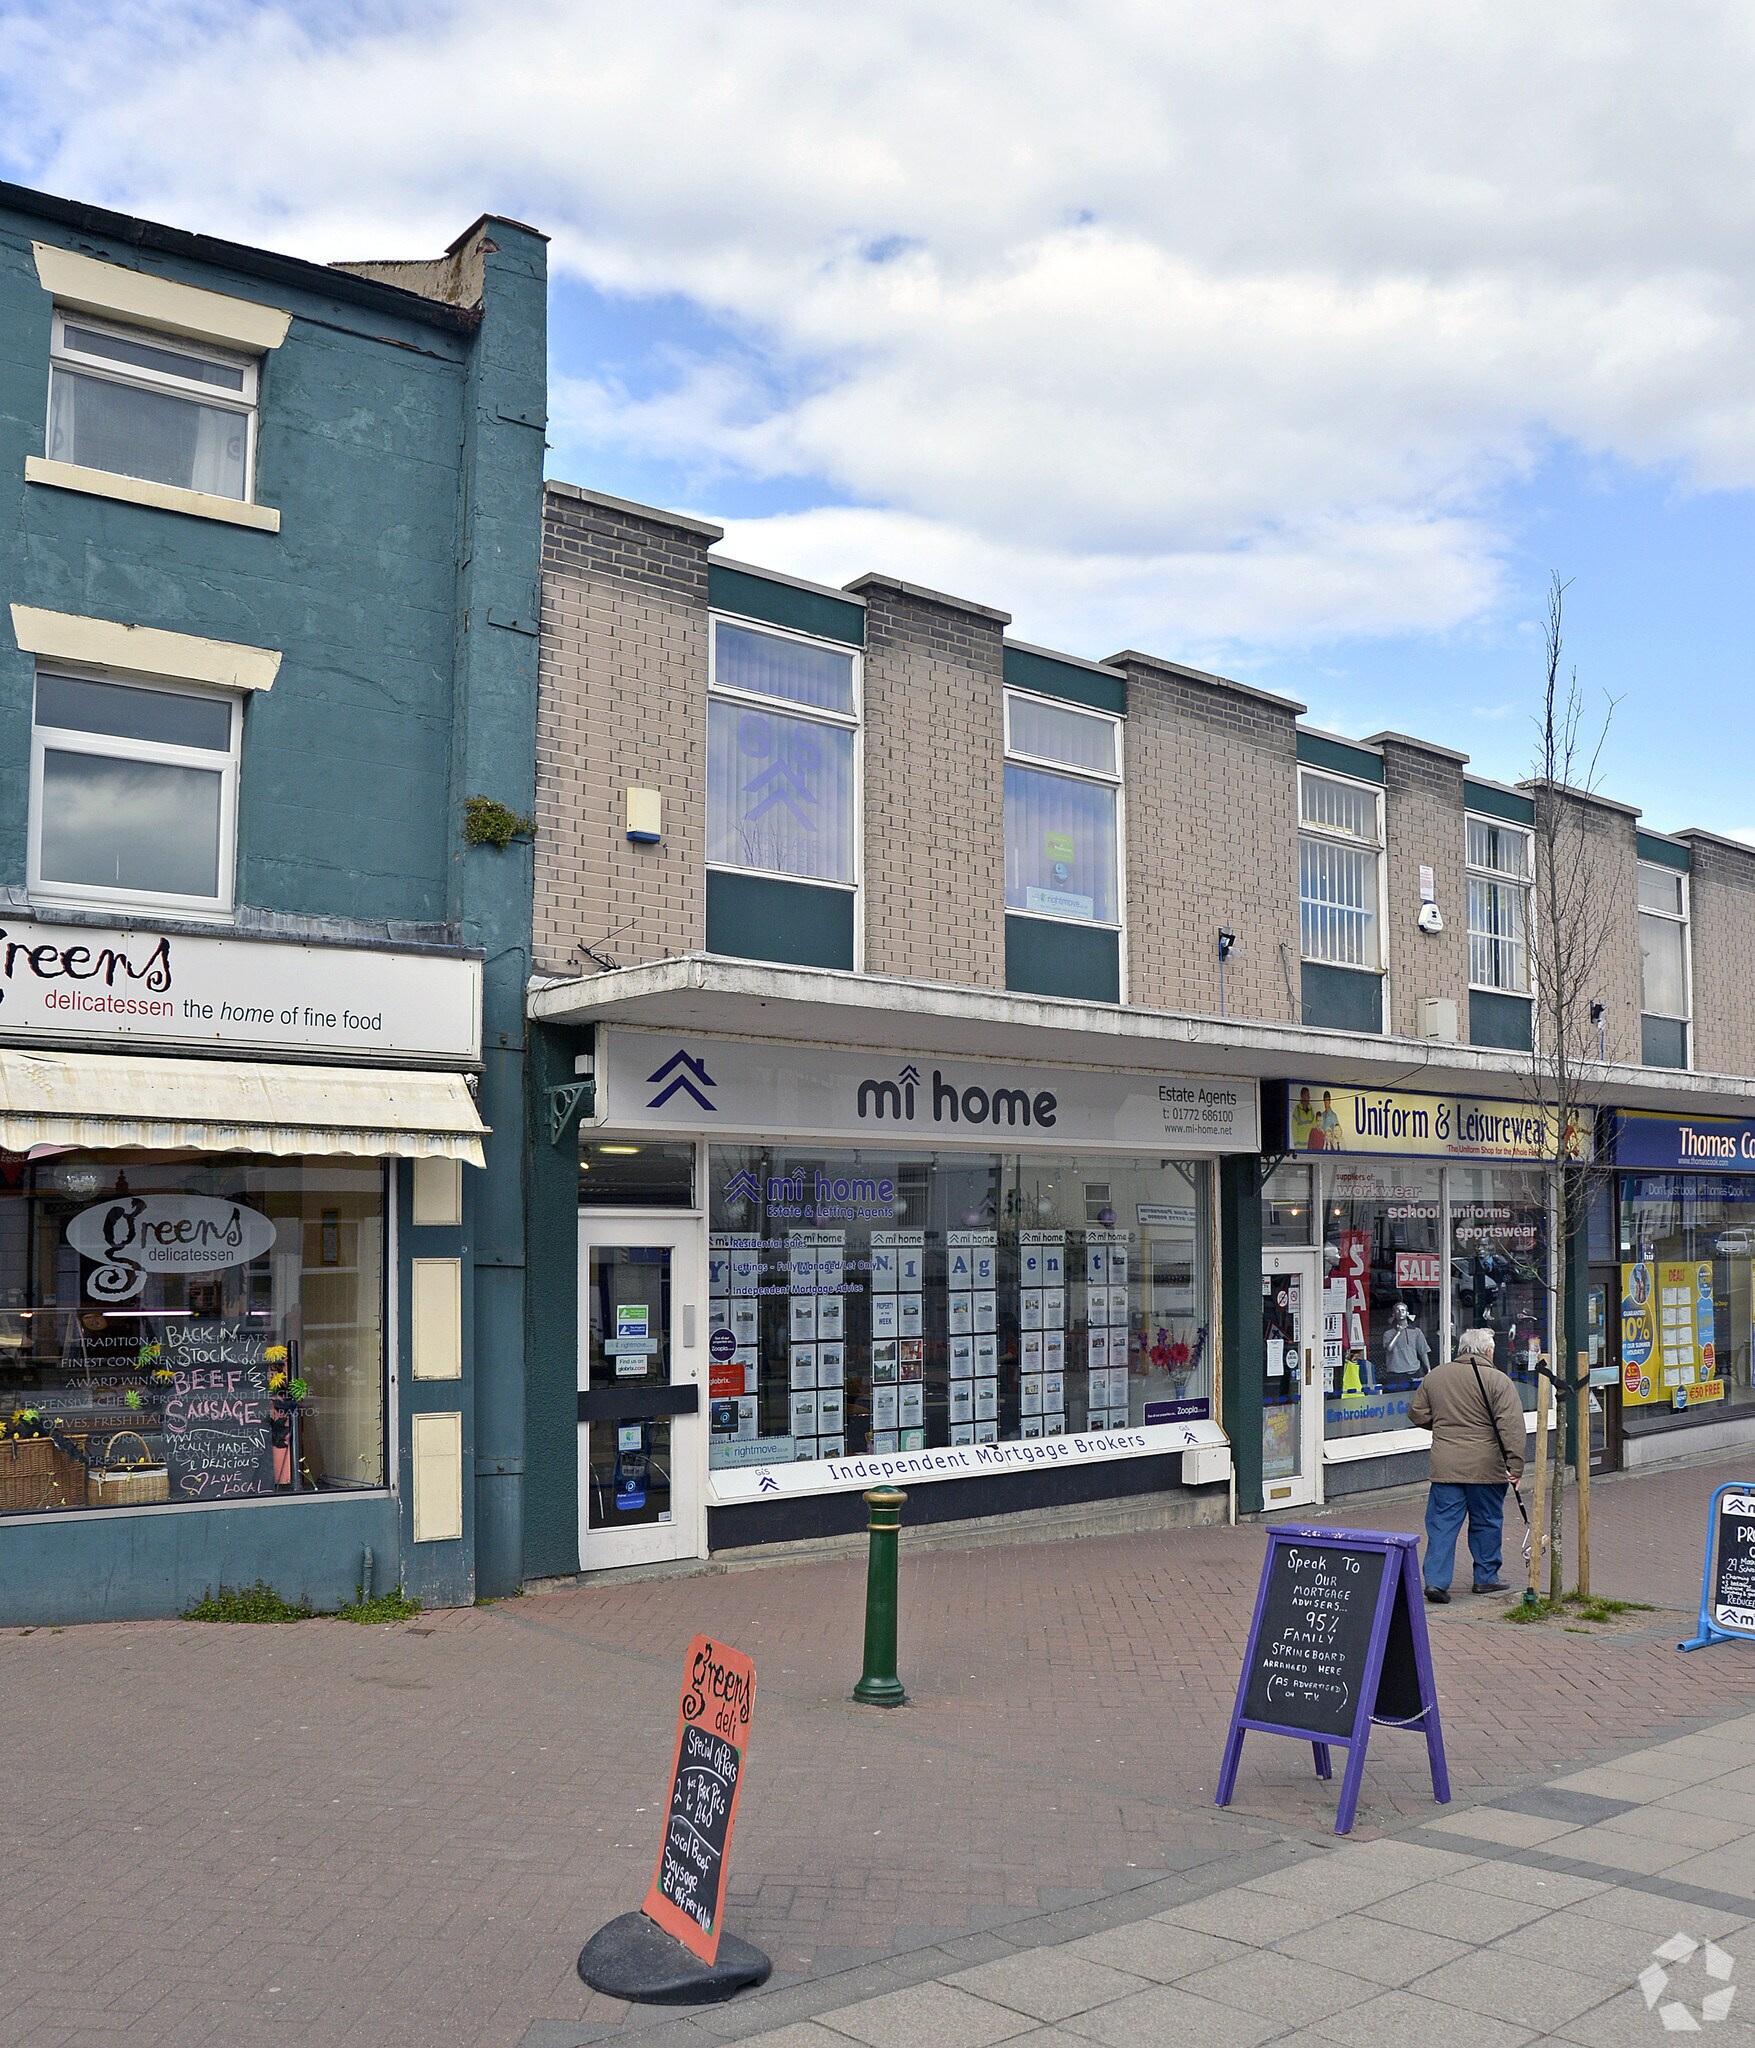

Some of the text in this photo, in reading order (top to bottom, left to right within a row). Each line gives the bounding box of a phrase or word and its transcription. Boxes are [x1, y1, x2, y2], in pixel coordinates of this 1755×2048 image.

[0, 930, 172, 997] reens
[45, 989, 382, 1031] delicatessen the home of fine food
[857, 1069, 1058, 1128] mi home
[1158, 1085, 1237, 1108] Estate Agents
[1162, 1107, 1234, 1122] t: 01772 686100
[1354, 1096, 1547, 1146] Uniform & Leisurewear
[1164, 1123, 1233, 1136] www.mi-home.net
[1678, 1126, 1737, 1158] Thomas
[1459, 1145, 1480, 1153] Uniform
[1481, 1146, 1494, 1156] Shop
[1503, 1147, 1511, 1155] the
[1677, 1157, 1729, 1167] www.thomascook.com
[1336, 1172, 1366, 1182] suppliers
[814, 1170, 895, 1202] home
[1337, 1182, 1422, 1198] workwear
[766, 1203, 894, 1220] Estate & Letting Agents
[1387, 1205, 1511, 1219] school uniforms
[817, 1233, 842, 1243] home
[899, 1234, 922, 1244] home
[972, 1234, 995, 1243] home
[1042, 1233, 1064, 1243] home
[1456, 1225, 1538, 1241] sportswear
[86, 1198, 244, 1301] greens
[733, 1238, 783, 1249] Residential
[784, 1239, 807, 1249] Sales
[148, 1247, 235, 1263] delicatessen
[1274, 1257, 1280, 1268] 6
[733, 1262, 768, 1275] Lettings
[1399, 1259, 1440, 1282] SALE
[733, 1282, 864, 1298] Independent Mortgage Advice
[165, 1325, 214, 1348] BACK
[1621, 1316, 1650, 1342] 10%
[80, 1336, 166, 1348] TRADITIONAL
[227, 1333, 269, 1344] MEATS
[61, 1357, 104, 1369] FINEST
[66, 1377, 118, 1389] AWARD
[174, 1368, 242, 1396] BEEF
[1704, 1382, 1721, 1397] FREE
[152, 1394, 189, 1405] FROM
[195, 1391, 248, 1402] AROUND
[250, 1391, 273, 1400] THE
[94, 1415, 132, 1427] FRESH
[166, 1400, 262, 1433] SAUSAGE
[217, 1442, 251, 1454] MADE
[827, 1435, 1146, 1480] Independent Mortgage Brokers
[211, 1471, 242, 1485] LOVE
[223, 1479, 274, 1494] LOCAL
[1287, 1549, 1361, 1574] Speak To
[1293, 1585, 1351, 1601] MORTGAGE
[1305, 1611, 1340, 1634] 95%
[1283, 1627, 1335, 1644] FAMILY
[1271, 1641, 1346, 1662] SPRINGBOARD
[1263, 1658, 1342, 1676] ARRANGED HERE
[682, 1642, 750, 1725] greens
[1293, 1679, 1341, 1693] ADVERTISED
[715, 1702, 737, 1741] deli
[687, 1729, 715, 1761] Special
[673, 1778, 683, 1804] 2
[670, 1822, 712, 1878] Local Beef
[665, 1846, 698, 1894] Sausage
[663, 1871, 675, 1893] £1
